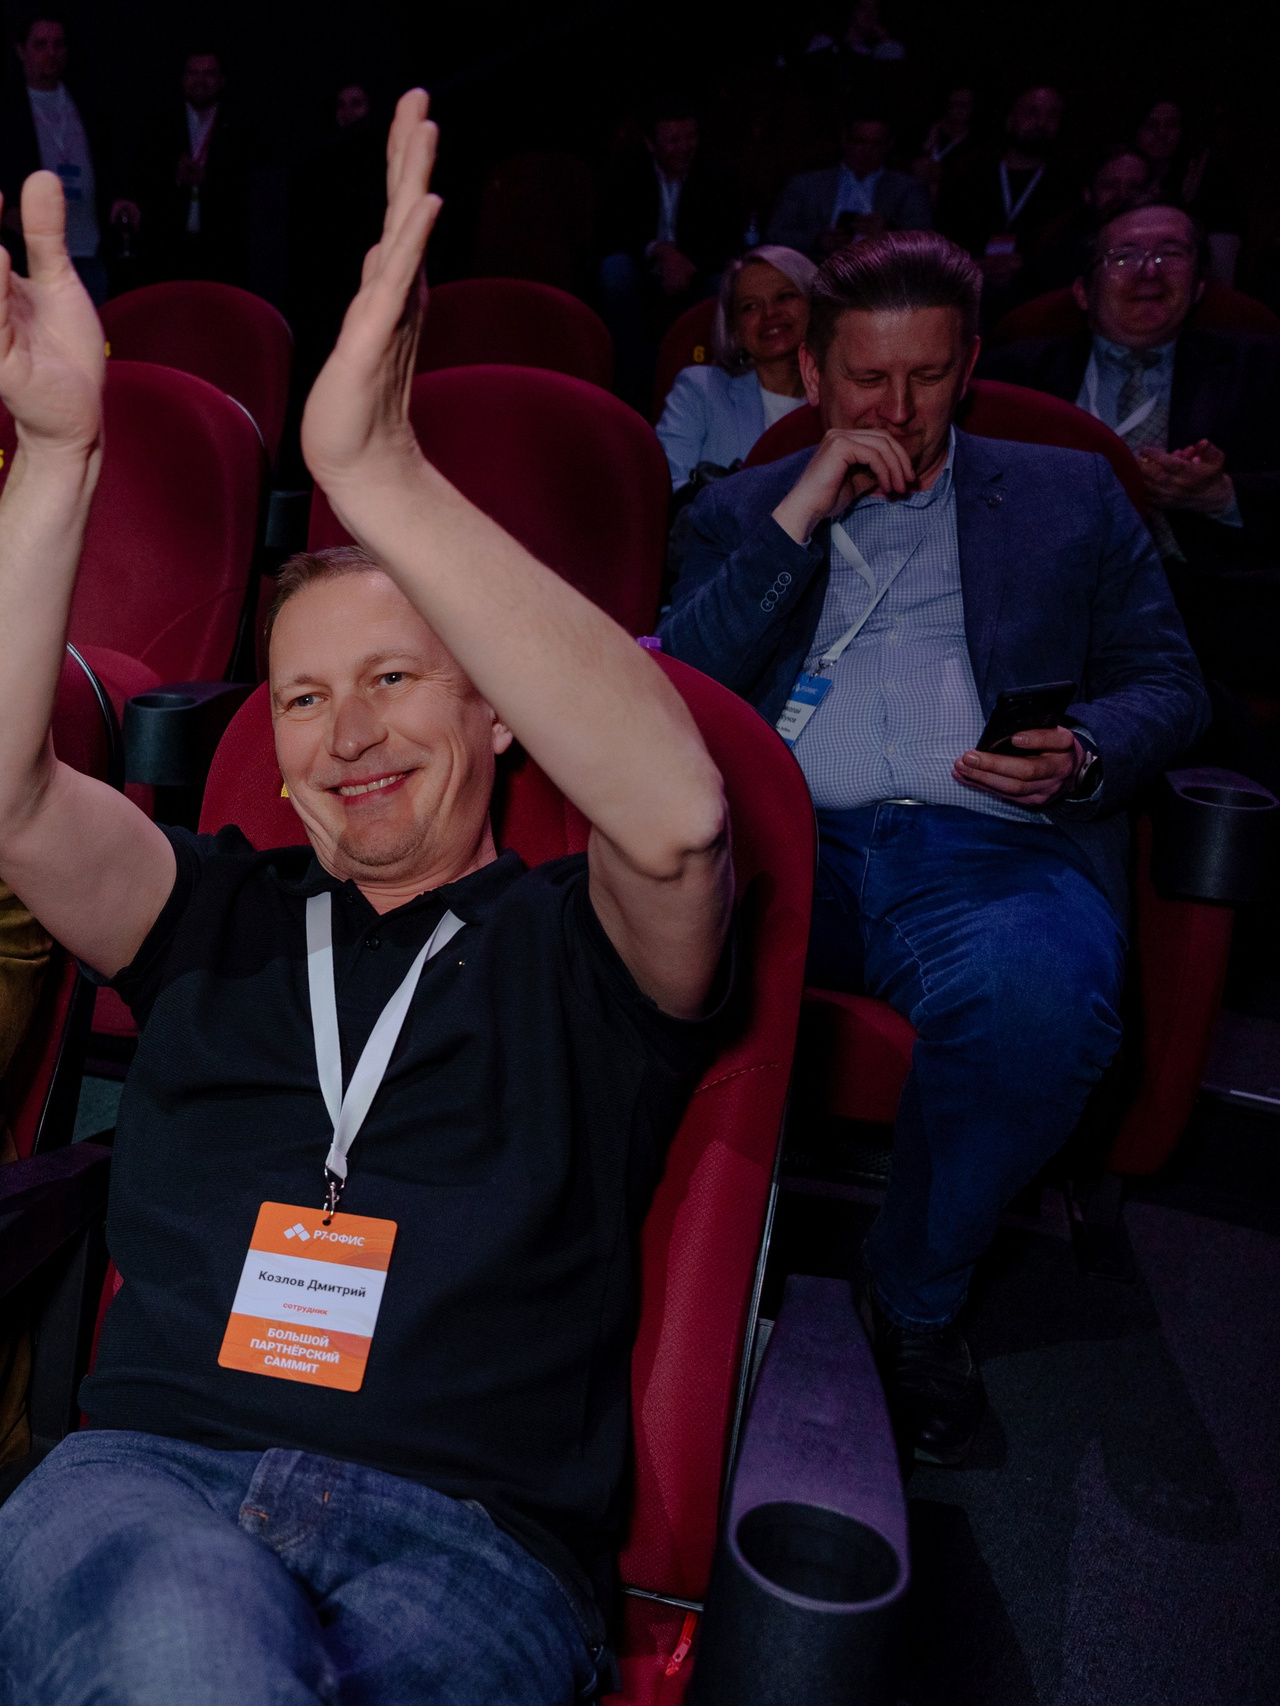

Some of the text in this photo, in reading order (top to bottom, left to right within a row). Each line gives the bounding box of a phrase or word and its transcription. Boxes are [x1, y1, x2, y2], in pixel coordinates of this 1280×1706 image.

[313, 1229, 365, 1247] Р7-ОФИС
[258, 1270, 367, 1298] Козлов Дмитрий
[282, 1302, 328, 1316] сотрудник
[267, 1327, 330, 1347] БОЛЬШОЙ
[249, 1338, 340, 1364] ПАРТНЁРСКИЙ
[264, 1356, 320, 1374] САММИТ
